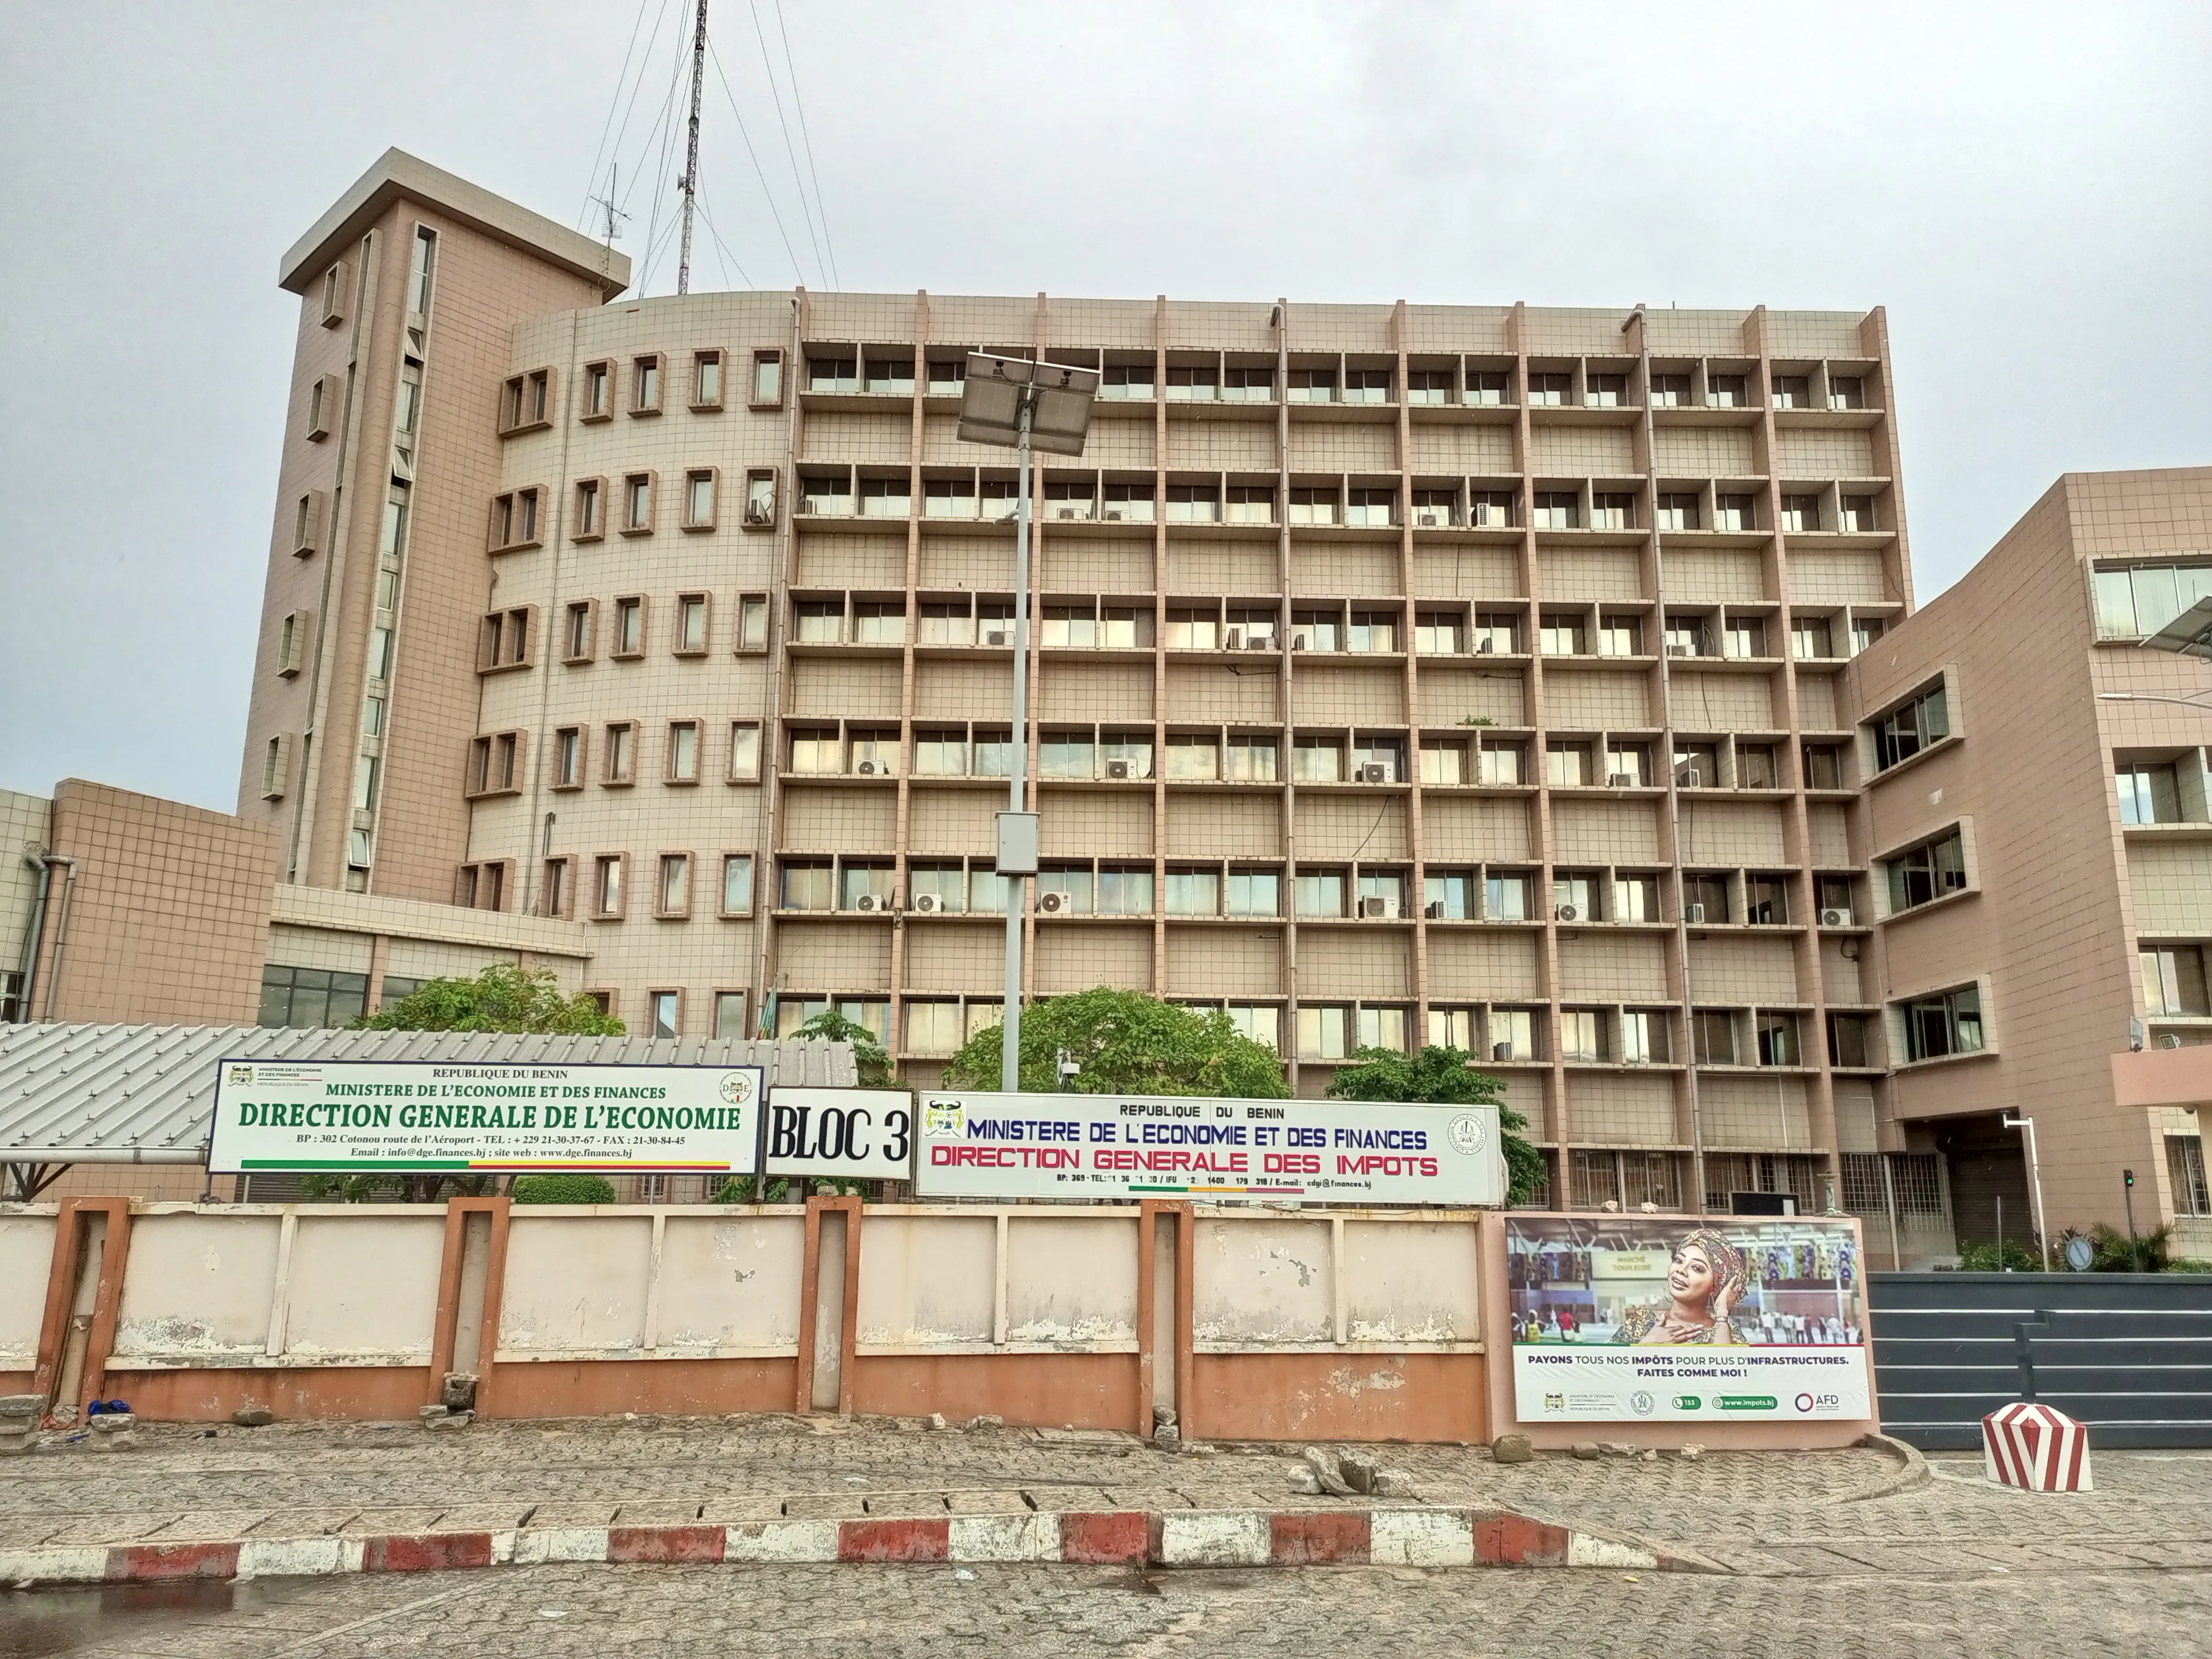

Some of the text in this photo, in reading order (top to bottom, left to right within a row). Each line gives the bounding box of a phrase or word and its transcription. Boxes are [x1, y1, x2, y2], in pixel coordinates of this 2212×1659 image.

[433, 1069, 568, 1080] REPUBLIQUE DU BENIN
[326, 1084, 413, 1097] MINISTERE
[416, 1084, 437, 1097] DE
[540, 1086, 559, 1098] ET
[562, 1086, 590, 1098] DES
[594, 1087, 666, 1099] FINANCES
[239, 1103, 392, 1128] DIRECTION
[399, 1104, 536, 1128] GENERALE
[544, 1106, 577, 1129] DE
[1120, 1104, 1284, 1119] REPUBLIQUE DU BENIN
[296, 1134, 311, 1143] BP
[319, 1134, 337, 1143] 302
[340, 1134, 380, 1143] Cotonou
[410, 1135, 421, 1143] de
[484, 1136, 505, 1144] TEL
[522, 1136, 539, 1144] 229
[541, 1136, 594, 1144] 21-30-37-67
[603, 1136, 624, 1144] FAX
[633, 1137, 686, 1145] 21-30-84-45
[768, 1105, 909, 1161] BLOC 3
[967, 1119, 1080, 1141] MINISTERE
[1090, 1123, 1116, 1143] DE
[1255, 1126, 1280, 1146] ET
[1287, 1127, 1326, 1147] DES
[1335, 1128, 1427, 1150] FINANCES
[387, 1148, 486, 1158] info@dge.finances.bj
[540, 1149, 632, 1158] www.dge.finances.bj
[932, 1146, 1438, 1176] DIRECTION GENERALE DES IMPOTS
[1275, 1178, 1302, 1187] E-mail:
[1575, 1356, 1603, 1364] TOUS
[1632, 1355, 1673, 1365] IMPÔTS
[1816, 1395, 1839, 1405] AFD
